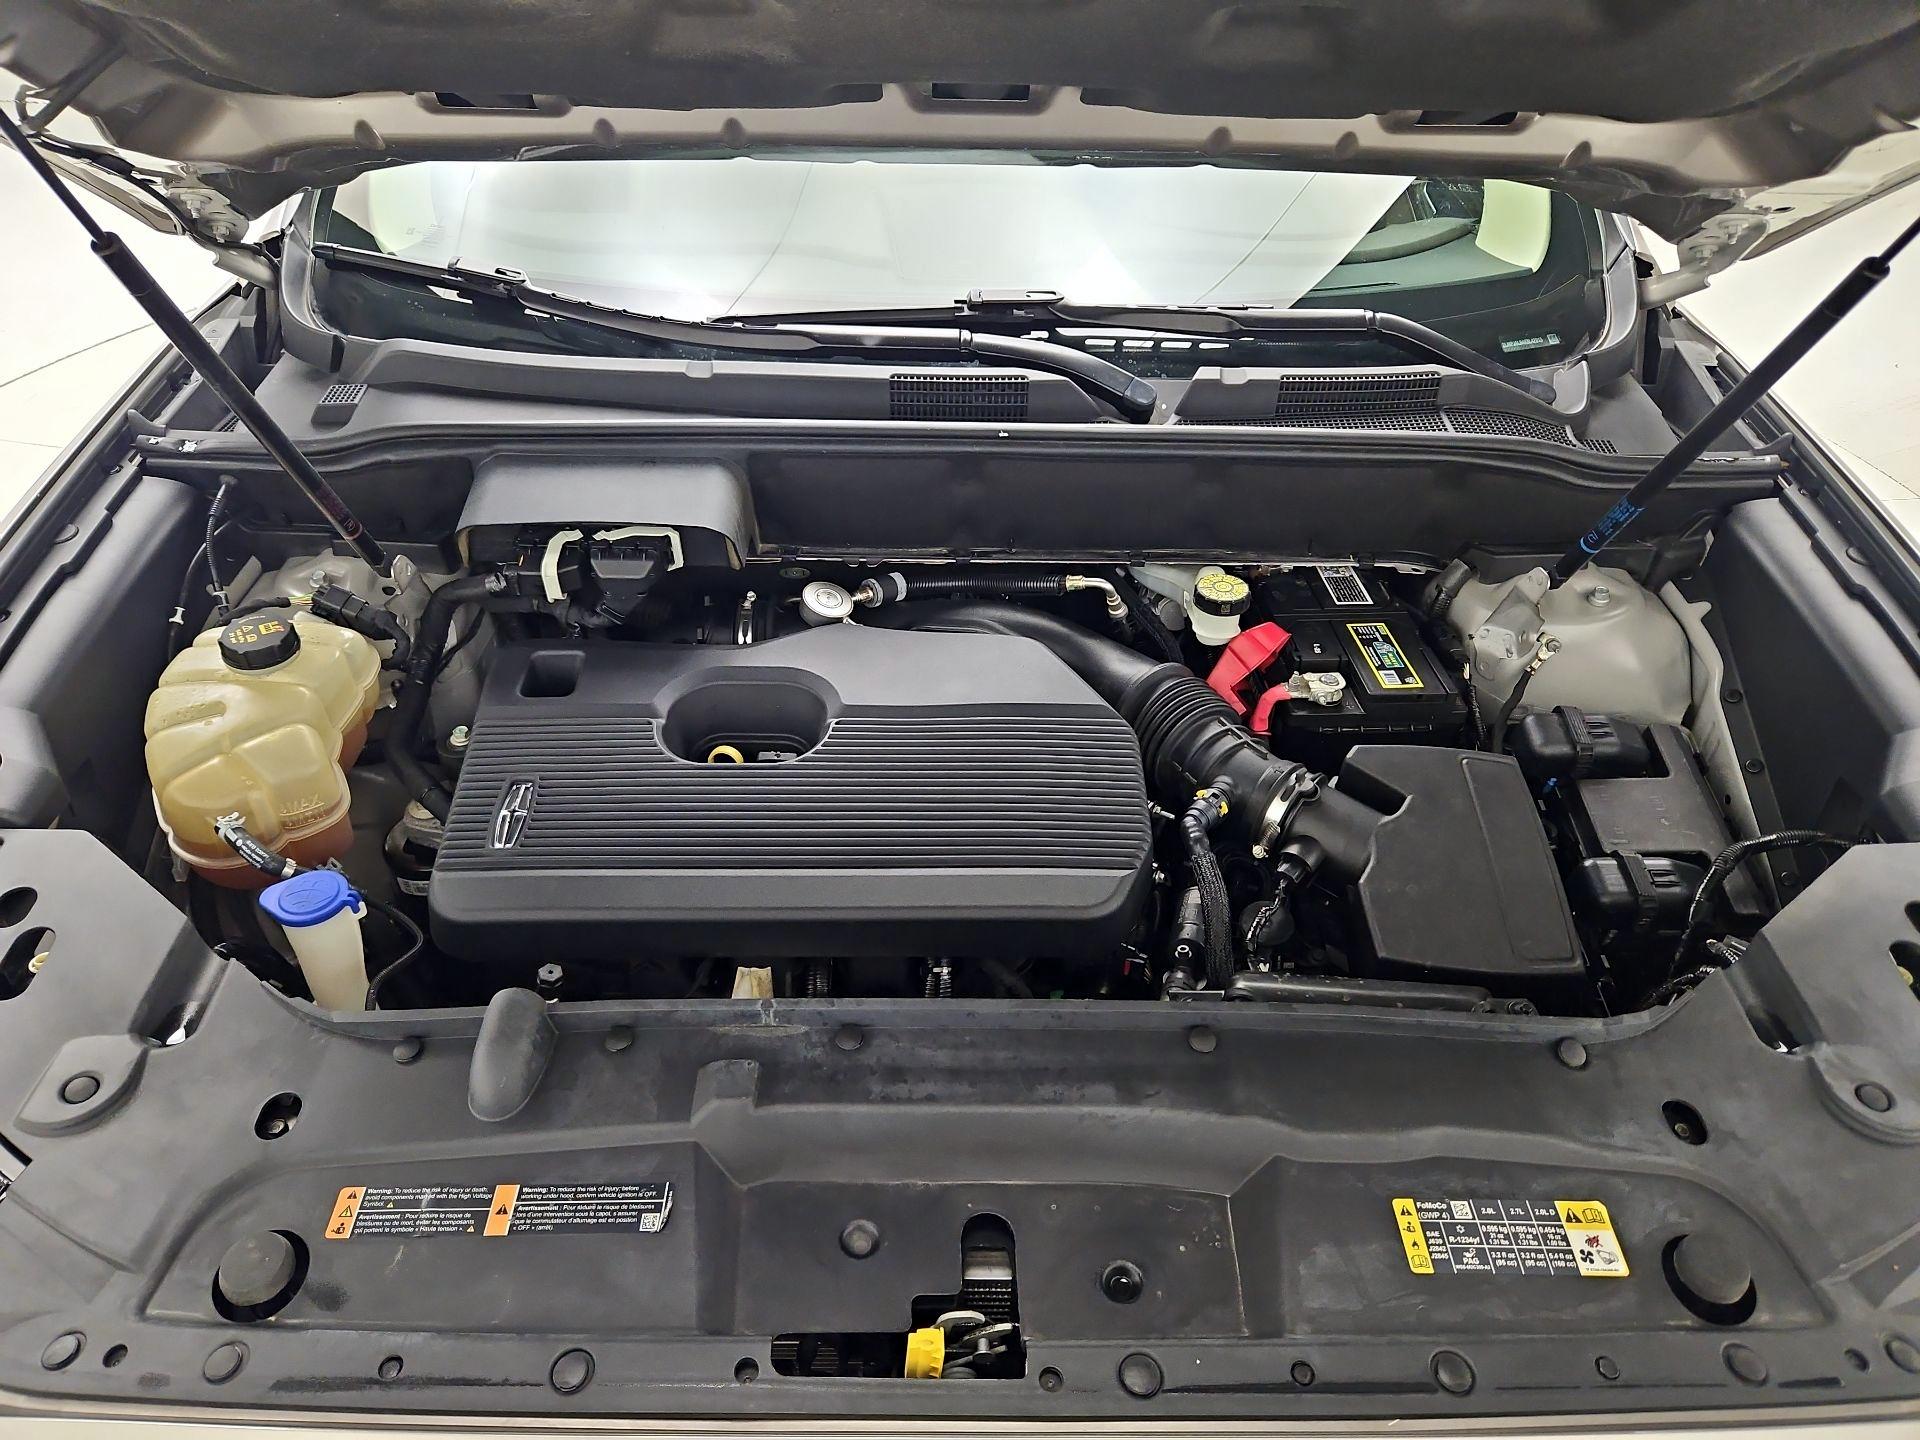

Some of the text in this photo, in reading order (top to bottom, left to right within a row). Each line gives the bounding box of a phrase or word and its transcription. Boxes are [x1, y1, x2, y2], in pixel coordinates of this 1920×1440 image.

[1416, 1202, 1447, 1210] FoMoCo
[1418, 1212, 1450, 1220] (GWP 4)
[1509, 1208, 1525, 1216] 2.7L
[1500, 1226, 1508, 1234] kg
[1528, 1226, 1537, 1235] kg
[1556, 1227, 1566, 1236] kg
